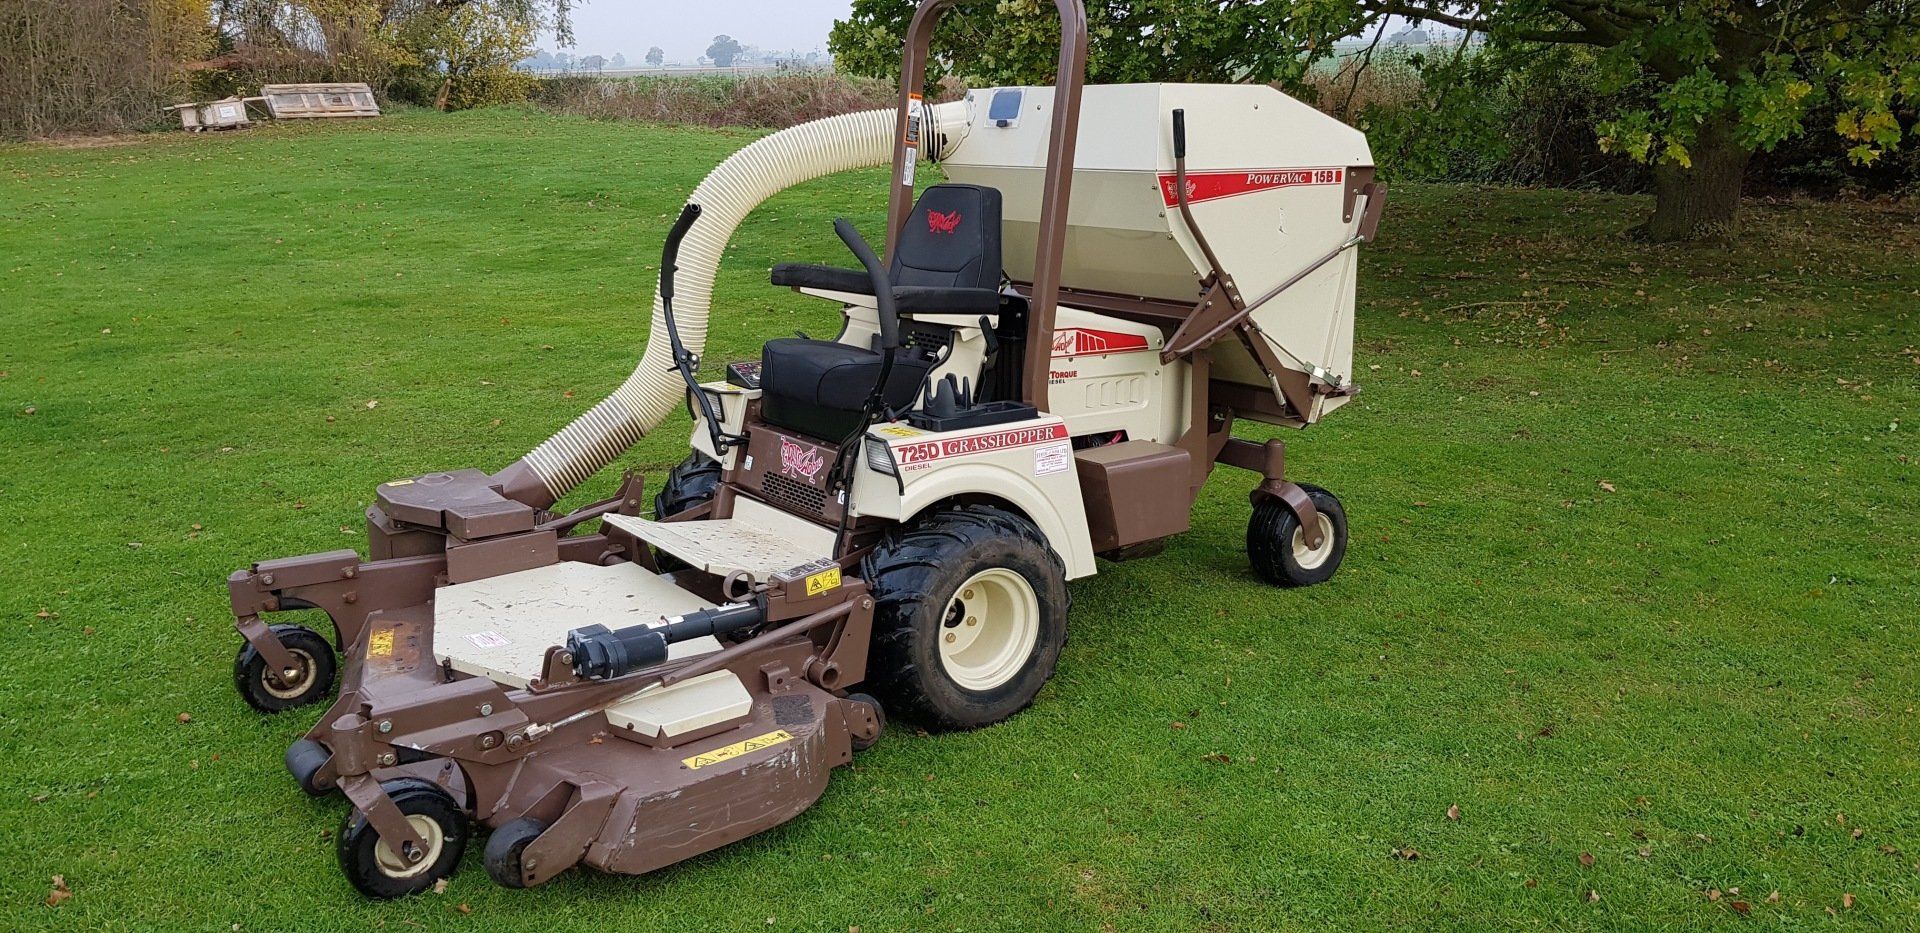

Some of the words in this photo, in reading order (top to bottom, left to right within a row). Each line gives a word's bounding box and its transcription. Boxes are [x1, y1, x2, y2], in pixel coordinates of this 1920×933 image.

[1246, 172, 1307, 184] POWERVAC
[1314, 170, 1334, 183] 15B
[898, 442, 940, 463] 725D
[947, 427, 1055, 454] GRASSHOPPER
[904, 463, 932, 471] DIESEL
